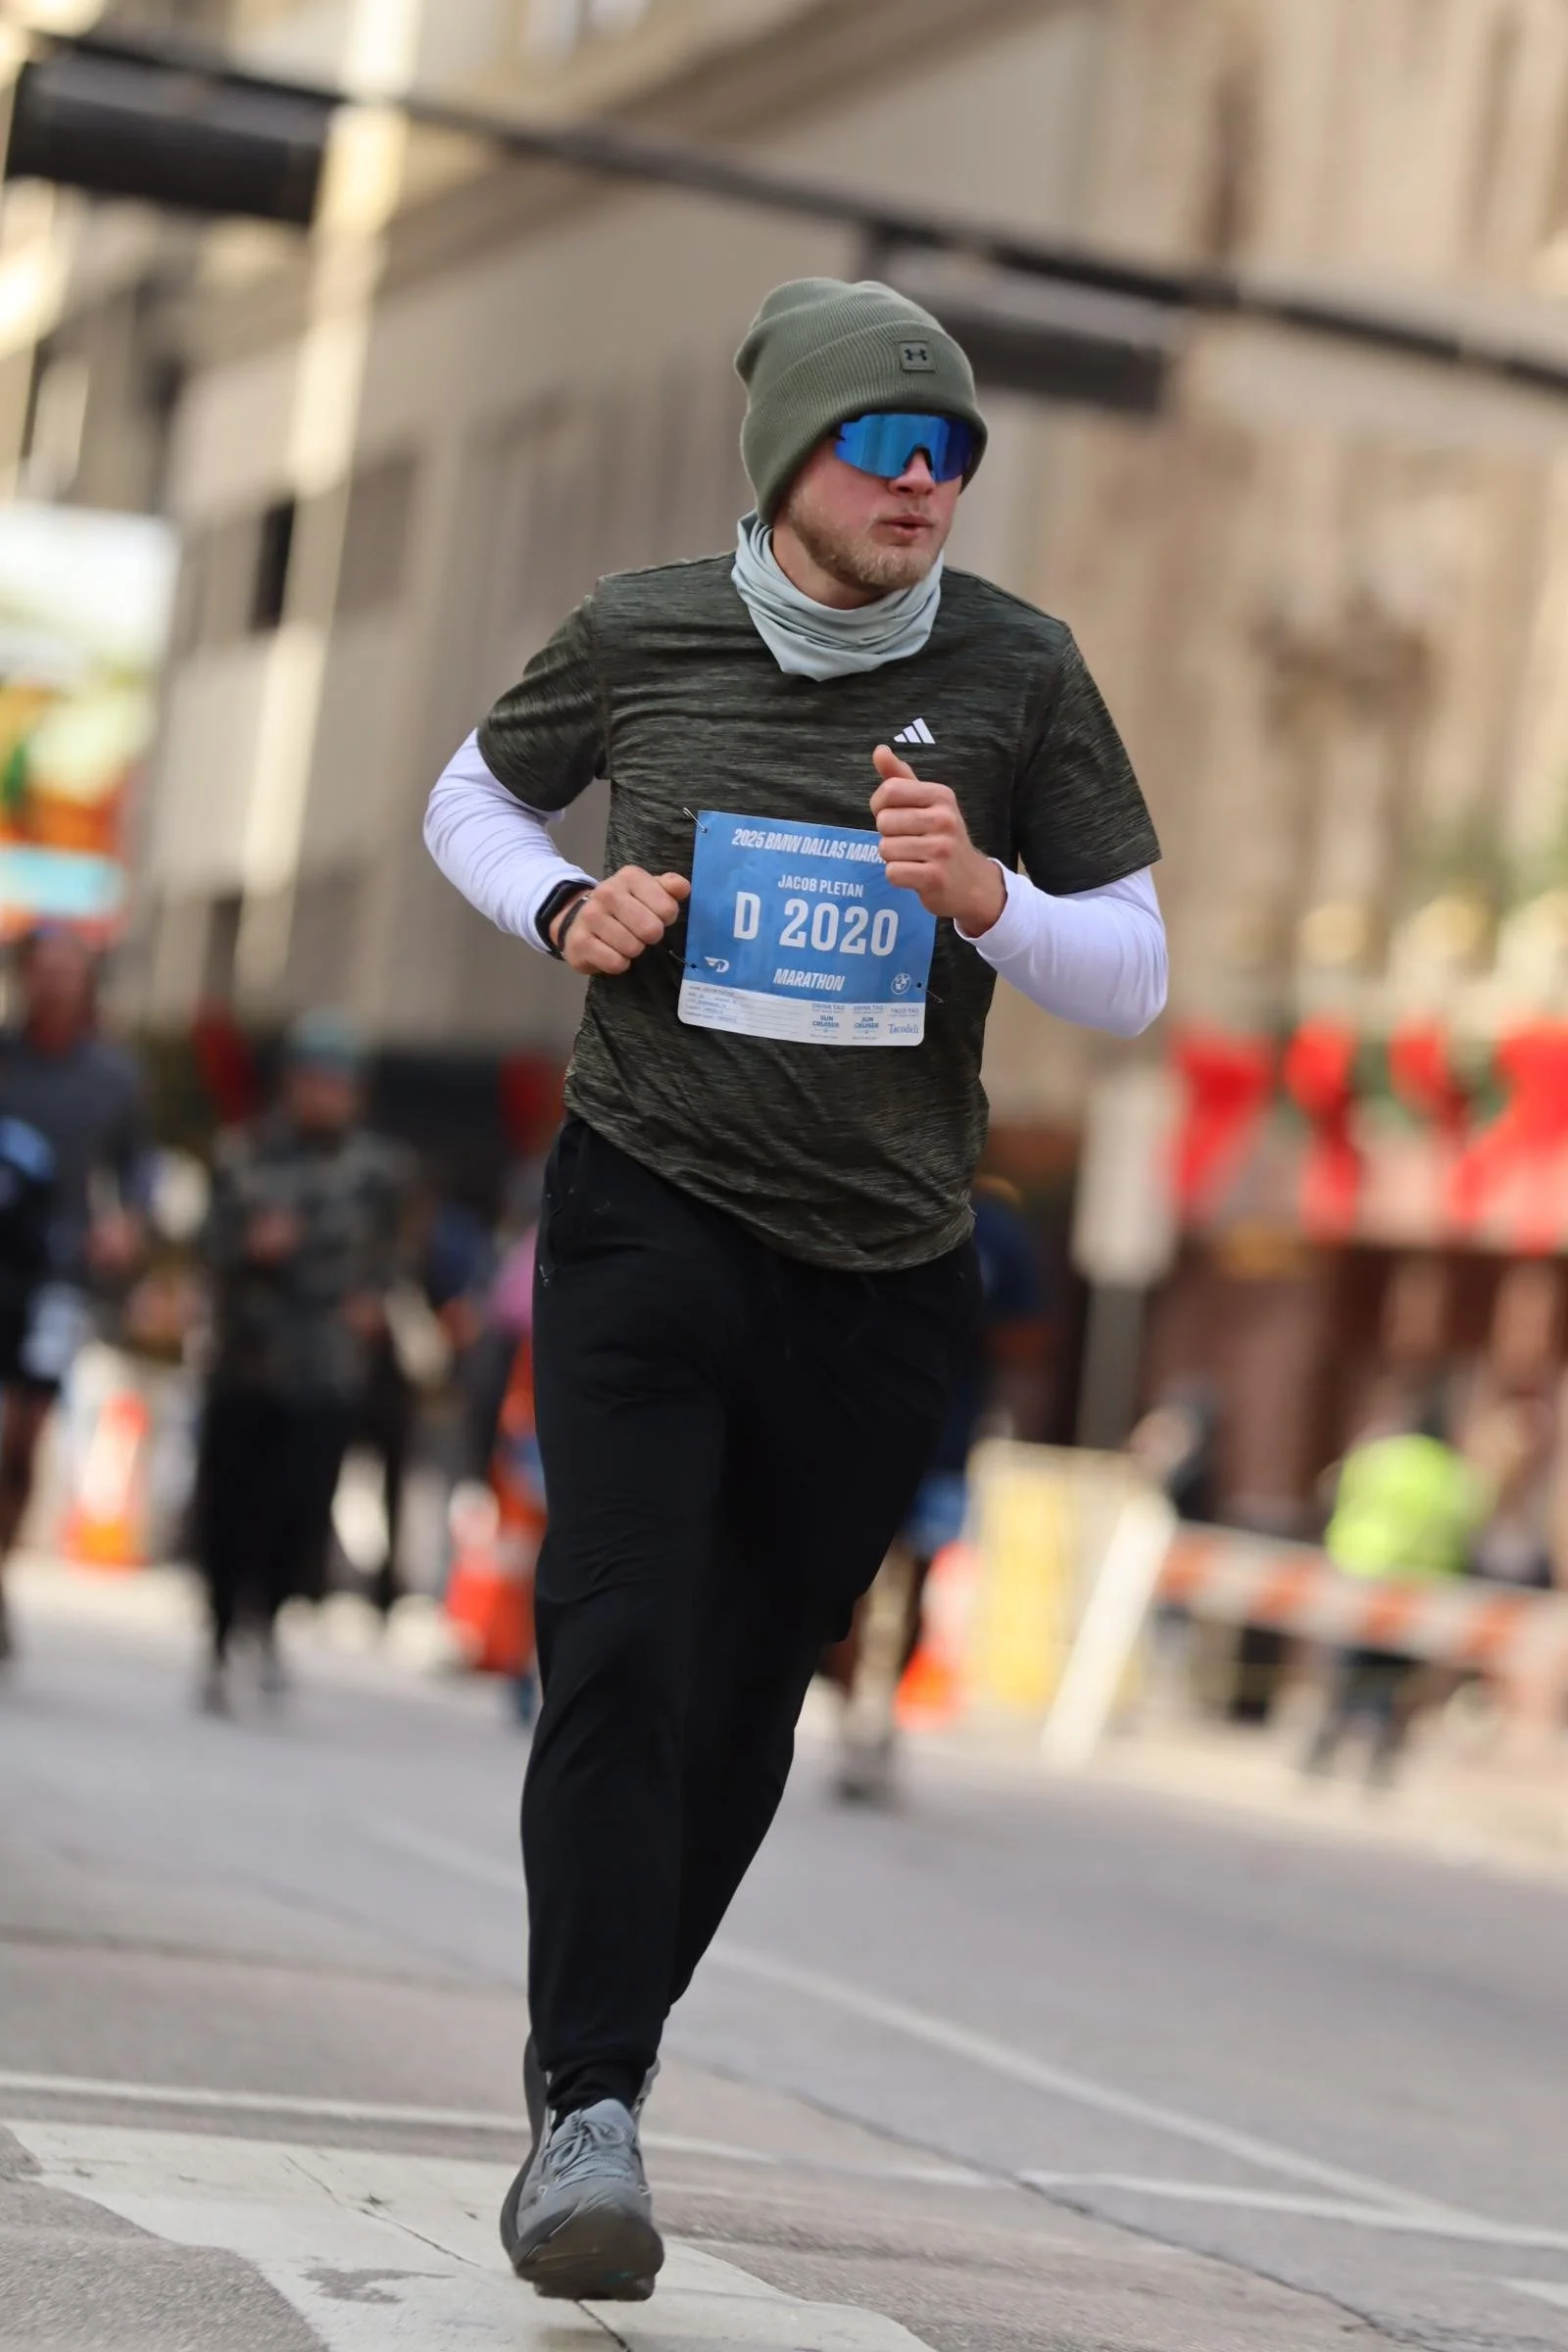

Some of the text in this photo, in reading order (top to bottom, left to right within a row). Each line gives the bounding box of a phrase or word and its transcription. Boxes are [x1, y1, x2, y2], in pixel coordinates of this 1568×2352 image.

[731, 828, 765, 849] 2025
[764, 832, 803, 854] BMW
[800, 836, 846, 859] DALLAS
[778, 874, 864, 899] JACOB PLETAN
[733, 891, 900, 956] D 2020
[772, 967, 846, 992] MARATHON
